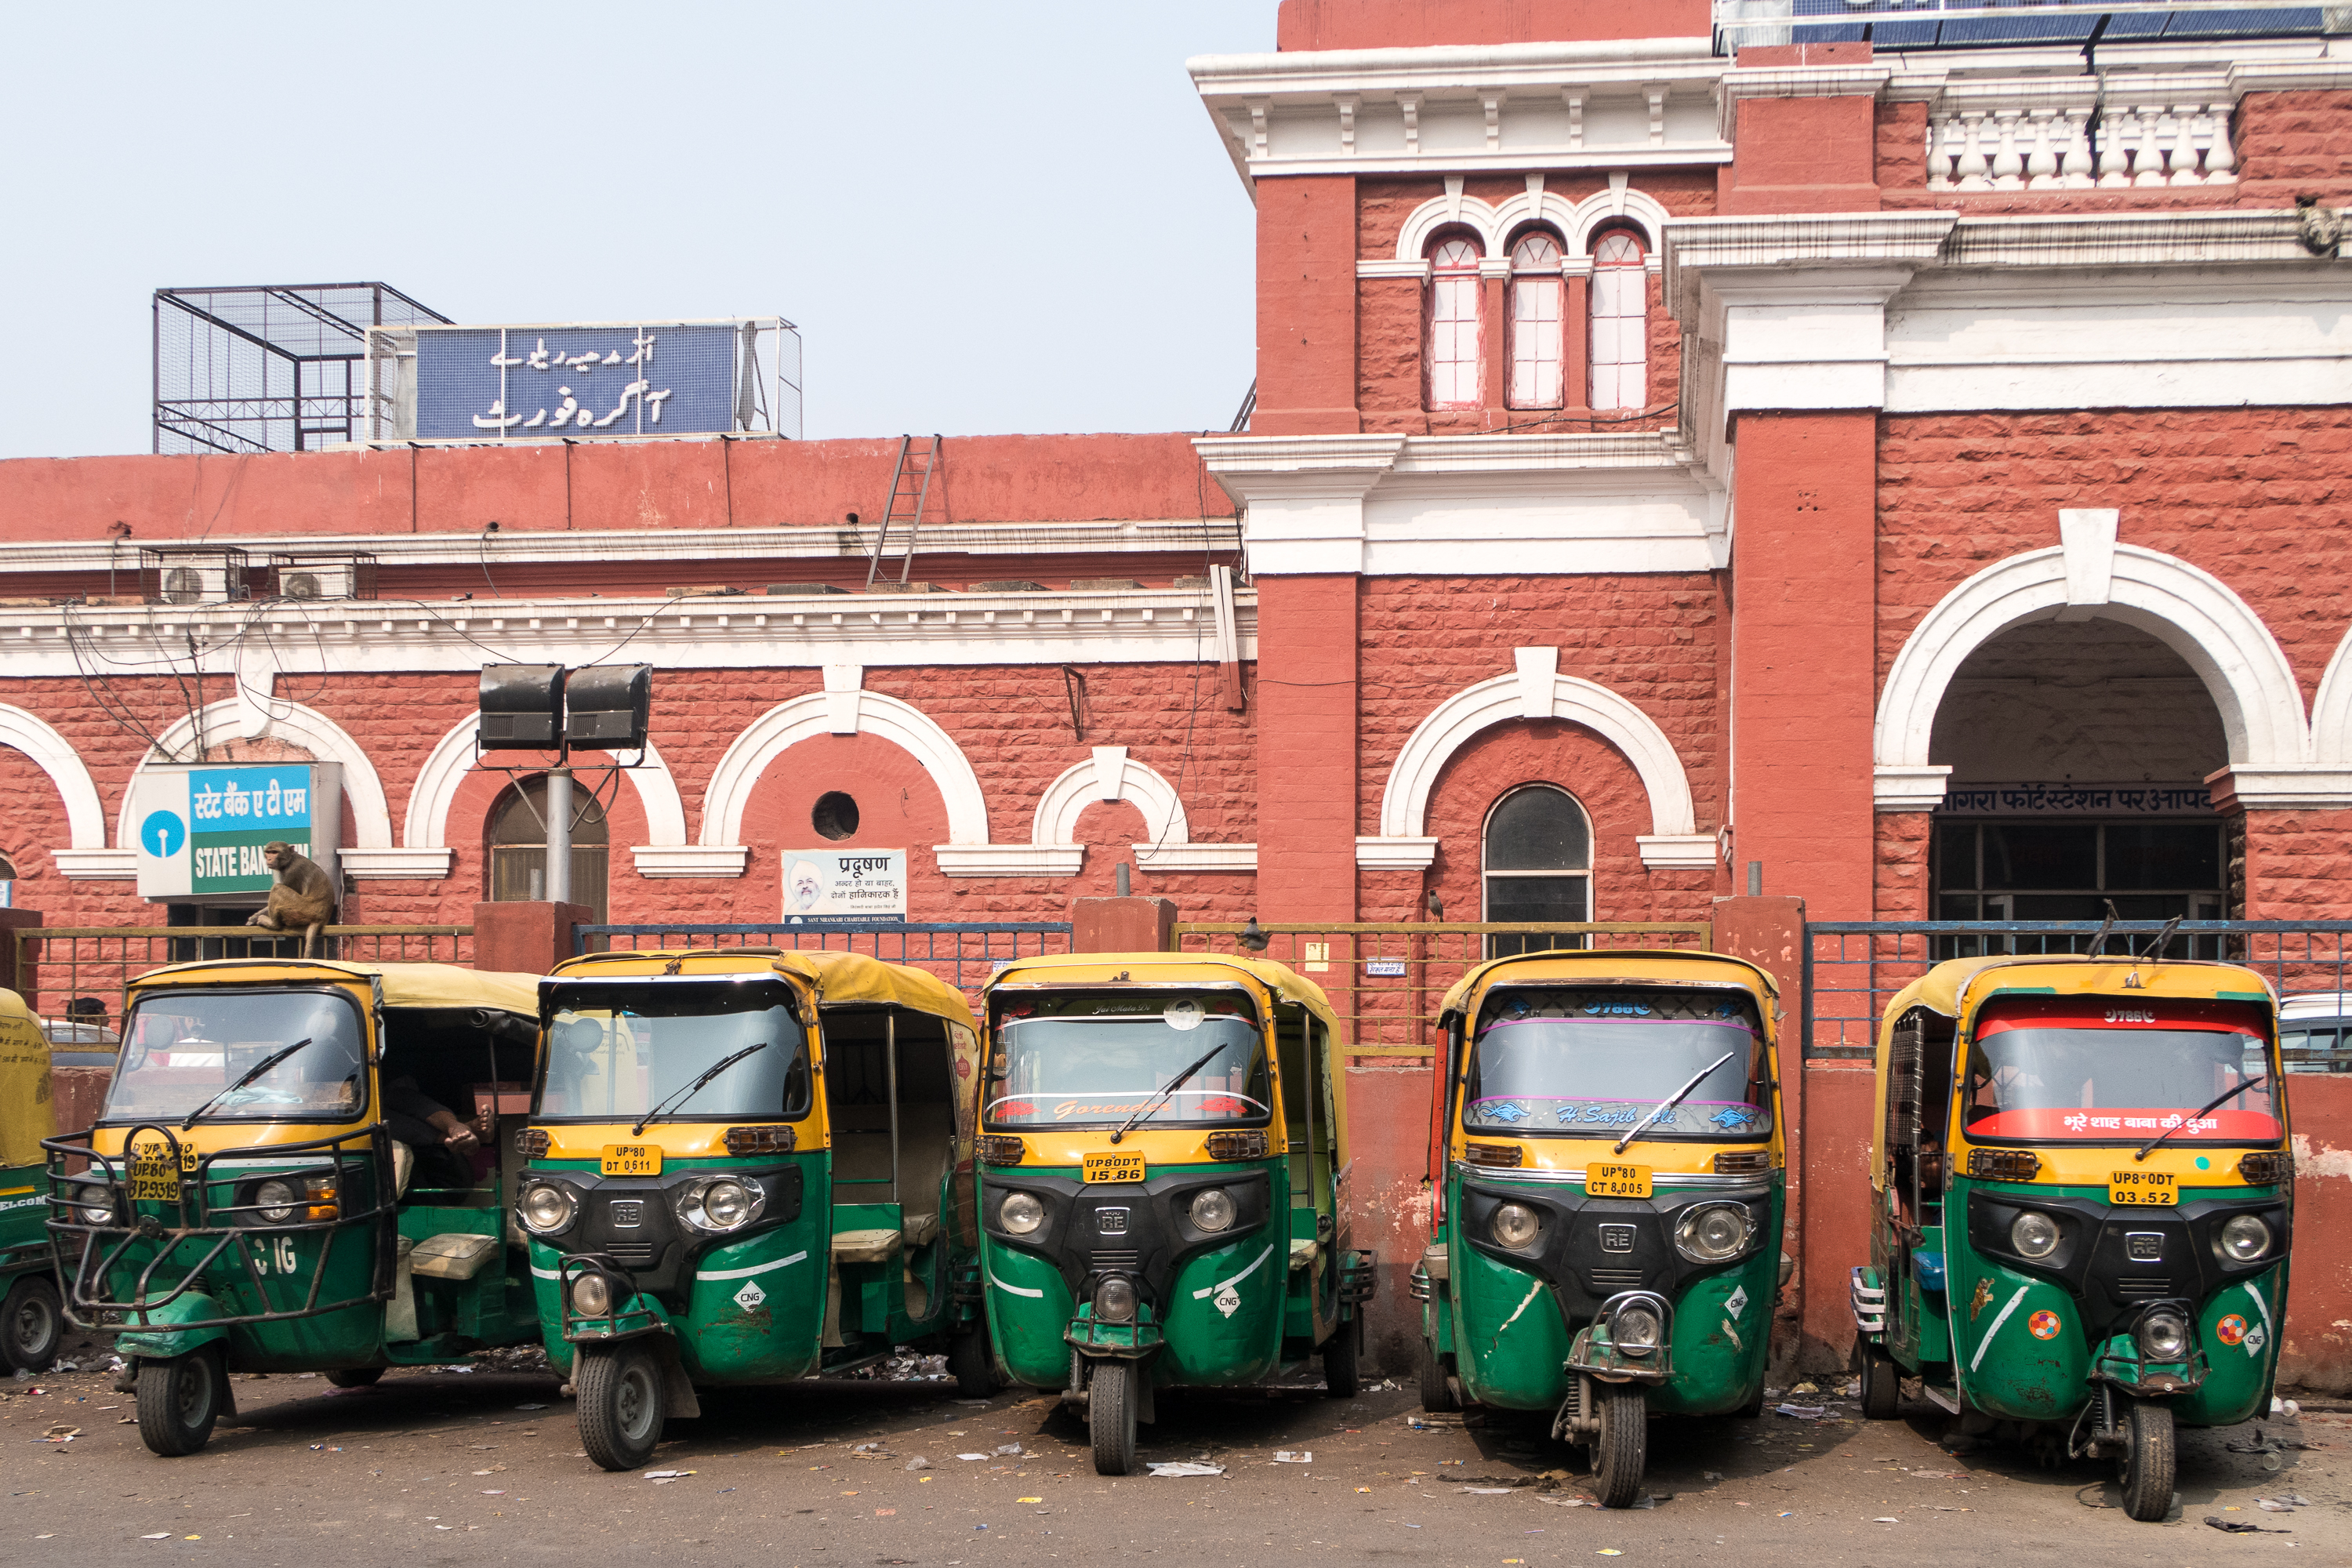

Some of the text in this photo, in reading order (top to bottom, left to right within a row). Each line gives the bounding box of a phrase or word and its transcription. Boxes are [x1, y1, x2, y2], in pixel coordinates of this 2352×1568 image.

[194, 779, 307, 819] स्टेट बैंक ए टी एम
[2001, 784, 2047, 811] फोर्ट
[2047, 784, 2113, 811] स्टेशन
[2116, 790, 2147, 811] पर
[195, 847, 238, 878] STATE
[240, 845, 273, 876] BAN
[838, 857, 891, 879] प्रदूषण
[855, 879, 862, 887] हो
[830, 891, 847, 899] दोनों
[848, 889, 891, 899] हानिकारक
[1602, 1002, 1633, 1014] 786
[2117, 1010, 2143, 1022] 786
[1053, 1099, 1172, 1120] Gorender
[2064, 1112, 2218, 1134] भूरे शाह बाबा की दुआ
[616, 1147, 645, 1157] UP 80
[607, 1160, 650, 1171] DT 0611
[1086, 1158, 1141, 1167] UP80DT
[1602, 1167, 1635, 1178] UP 80
[1592, 1181, 1607, 1192] CT
[616, 1209, 638, 1221] RE
[1102, 1216, 1124, 1229] RE
[1606, 1232, 1630, 1247] RE
[2133, 1241, 2158, 1254] RE
[740, 1292, 760, 1301] CNG
[1219, 1297, 1237, 1306] CNG
